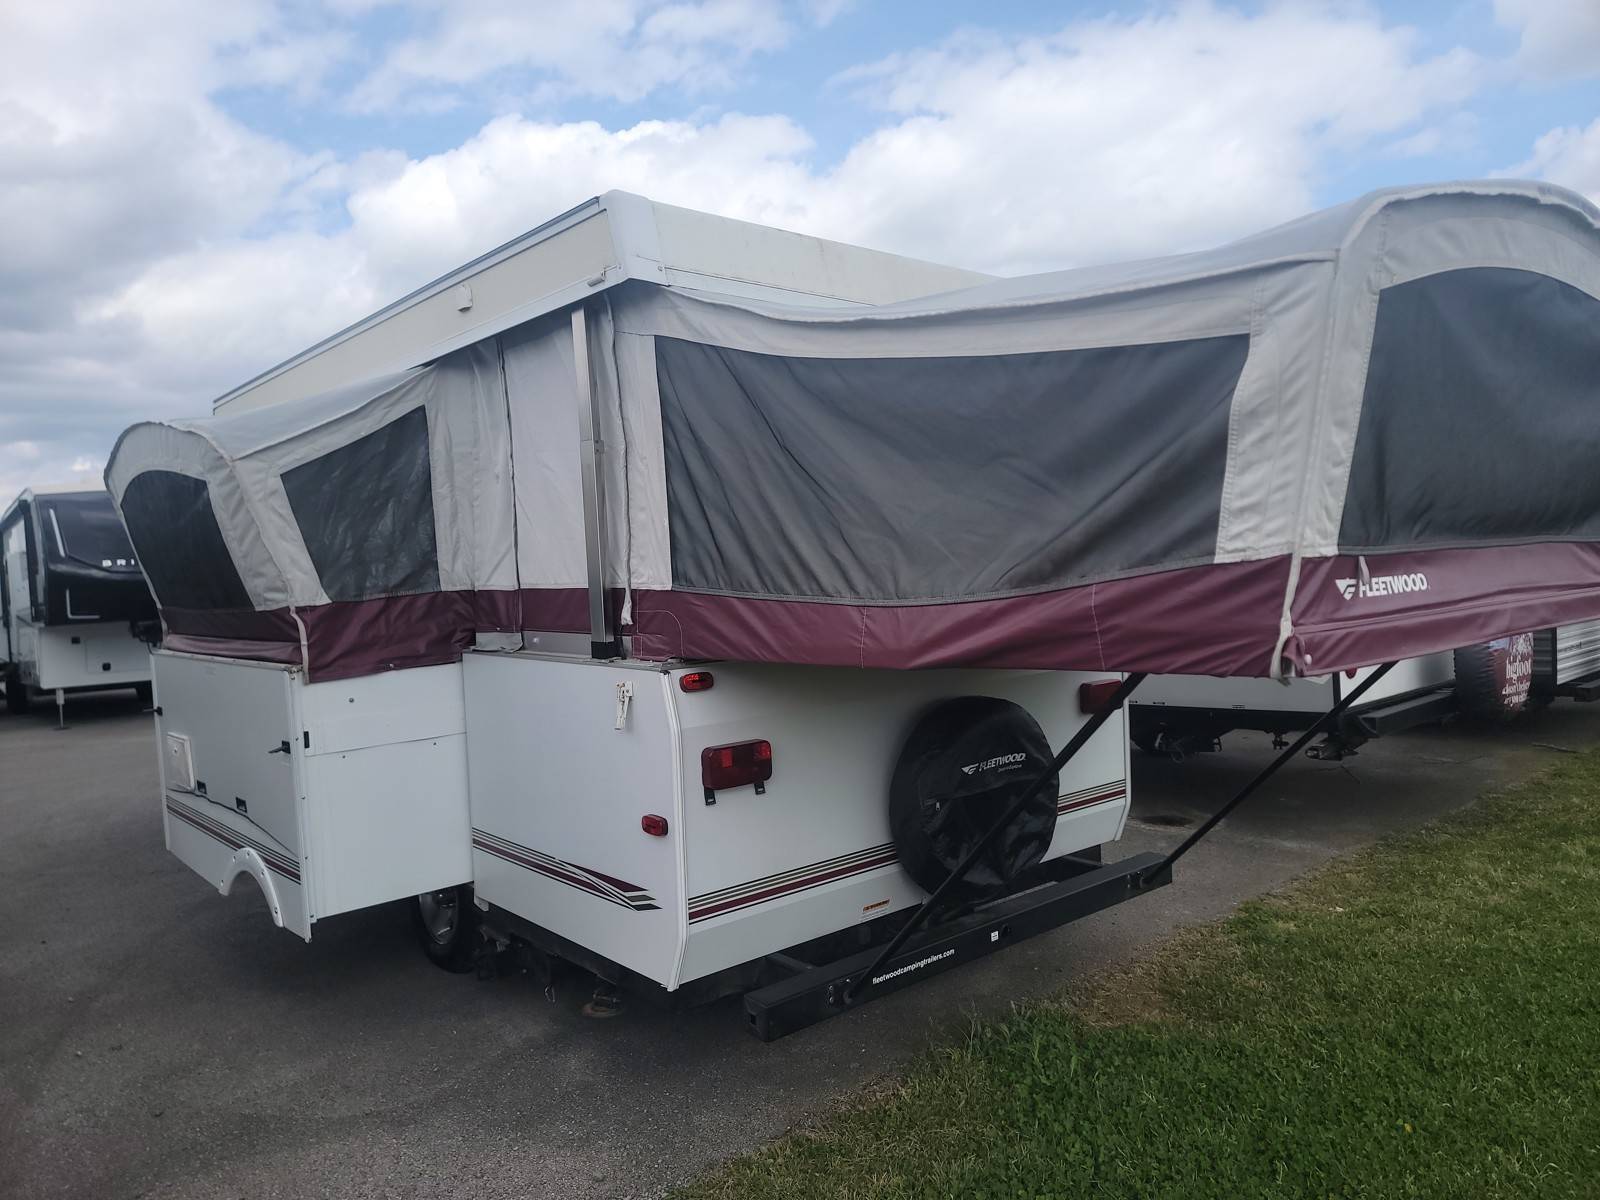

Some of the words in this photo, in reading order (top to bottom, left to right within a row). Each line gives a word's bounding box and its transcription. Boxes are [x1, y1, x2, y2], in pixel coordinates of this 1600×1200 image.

[1359, 573, 1428, 598] FLEETWOOD
[1506, 655, 1531, 683] bigfoot
[979, 753, 1026, 771] FLEETWOOD
[872, 948, 955, 985] fleetwoodcampingtrailers.com
